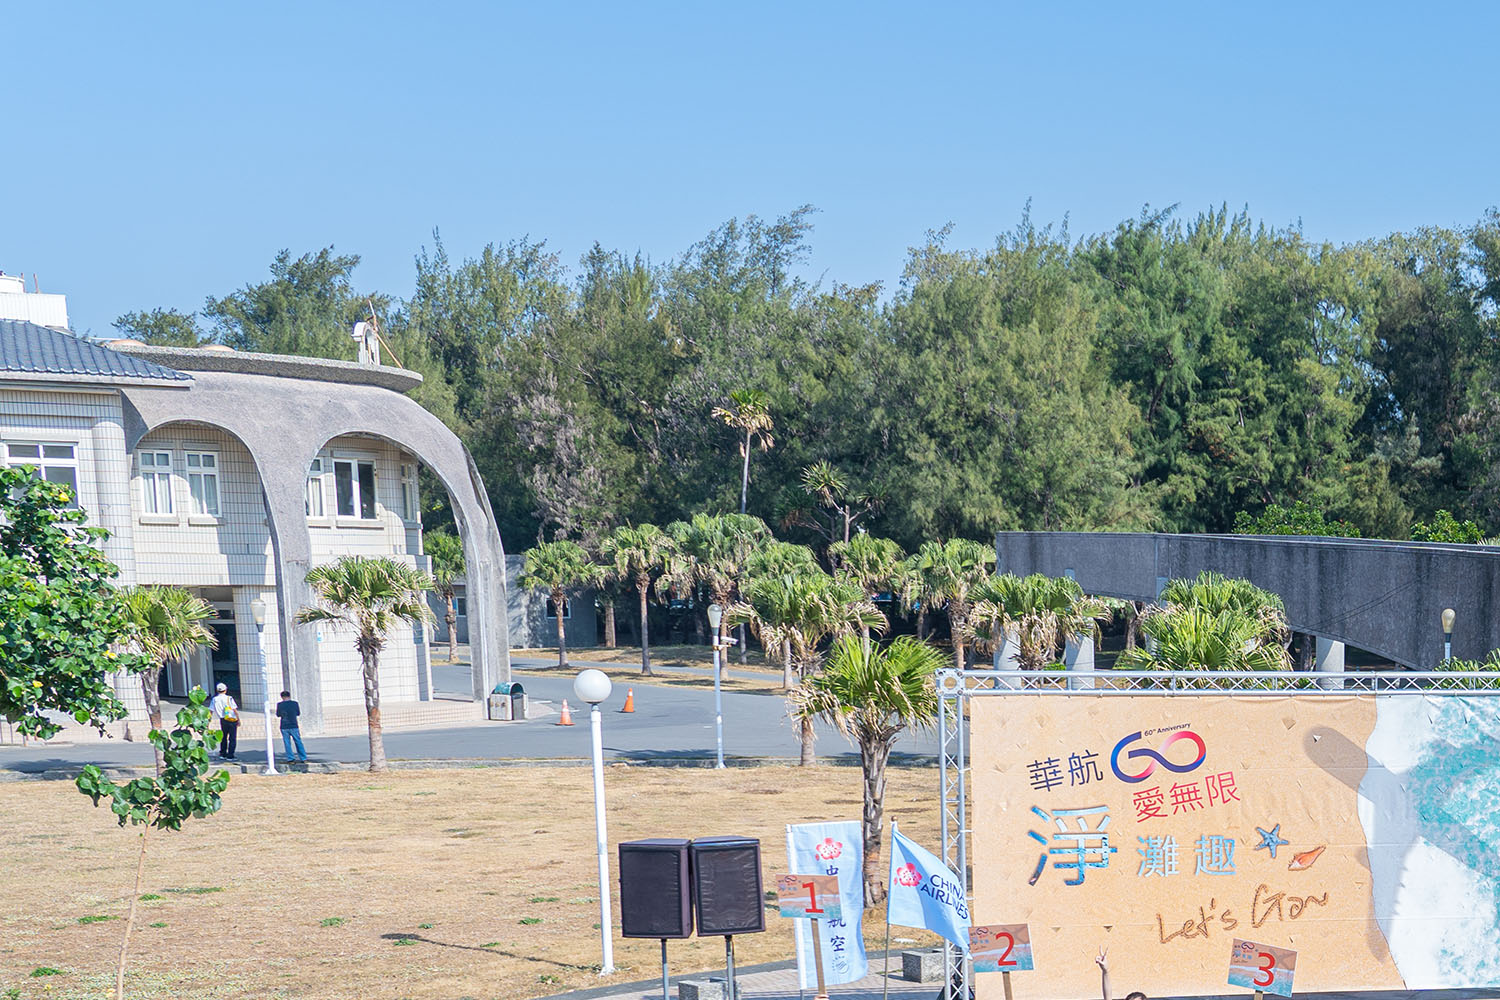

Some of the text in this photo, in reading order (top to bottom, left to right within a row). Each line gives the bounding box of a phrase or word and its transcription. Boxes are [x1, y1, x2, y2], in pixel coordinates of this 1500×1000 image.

[1157, 723, 1191, 734] Anniversary
[1026, 749, 1103, 792] 華航
[1132, 771, 1240, 823] 愛無限
[802, 882, 824, 913] 1
[930, 874, 965, 901] CHINA
[1156, 897, 1238, 944] Let's
[996, 932, 1017, 966] 2
[1253, 952, 1275, 987] 3
